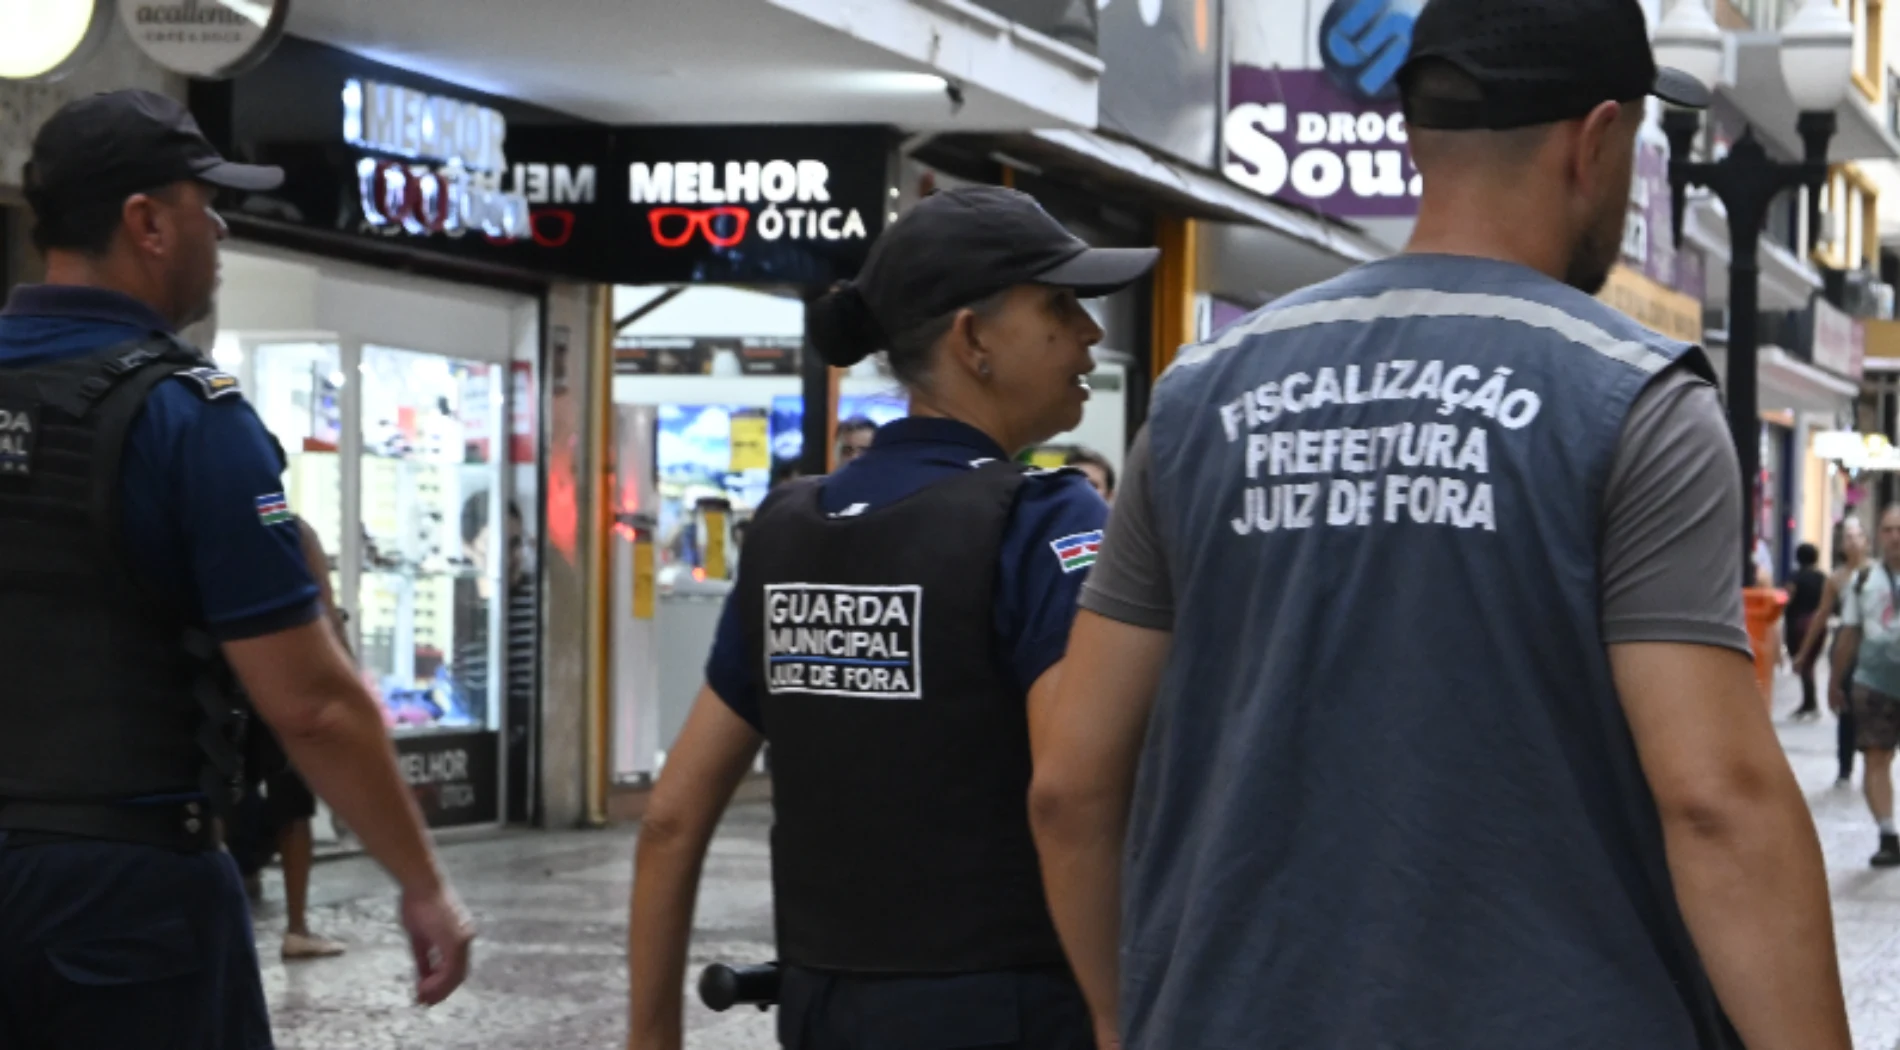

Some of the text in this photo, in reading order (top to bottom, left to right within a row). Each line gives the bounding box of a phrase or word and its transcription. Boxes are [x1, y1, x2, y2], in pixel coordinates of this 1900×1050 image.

[1223, 103, 1423, 197] Sou
[629, 160, 830, 203] MELHOR
[756, 203, 867, 241] ÓTICA
[1219, 360, 1542, 442] FISCALIZAÇÃO
[1246, 422, 1489, 478] PREFEITURA
[1231, 475, 1496, 535] JUIZ DE FORA
[770, 592, 909, 626] GUARDA
[770, 627, 909, 658] MUNICIPAL
[771, 663, 910, 690] JUIZ DE FORA
